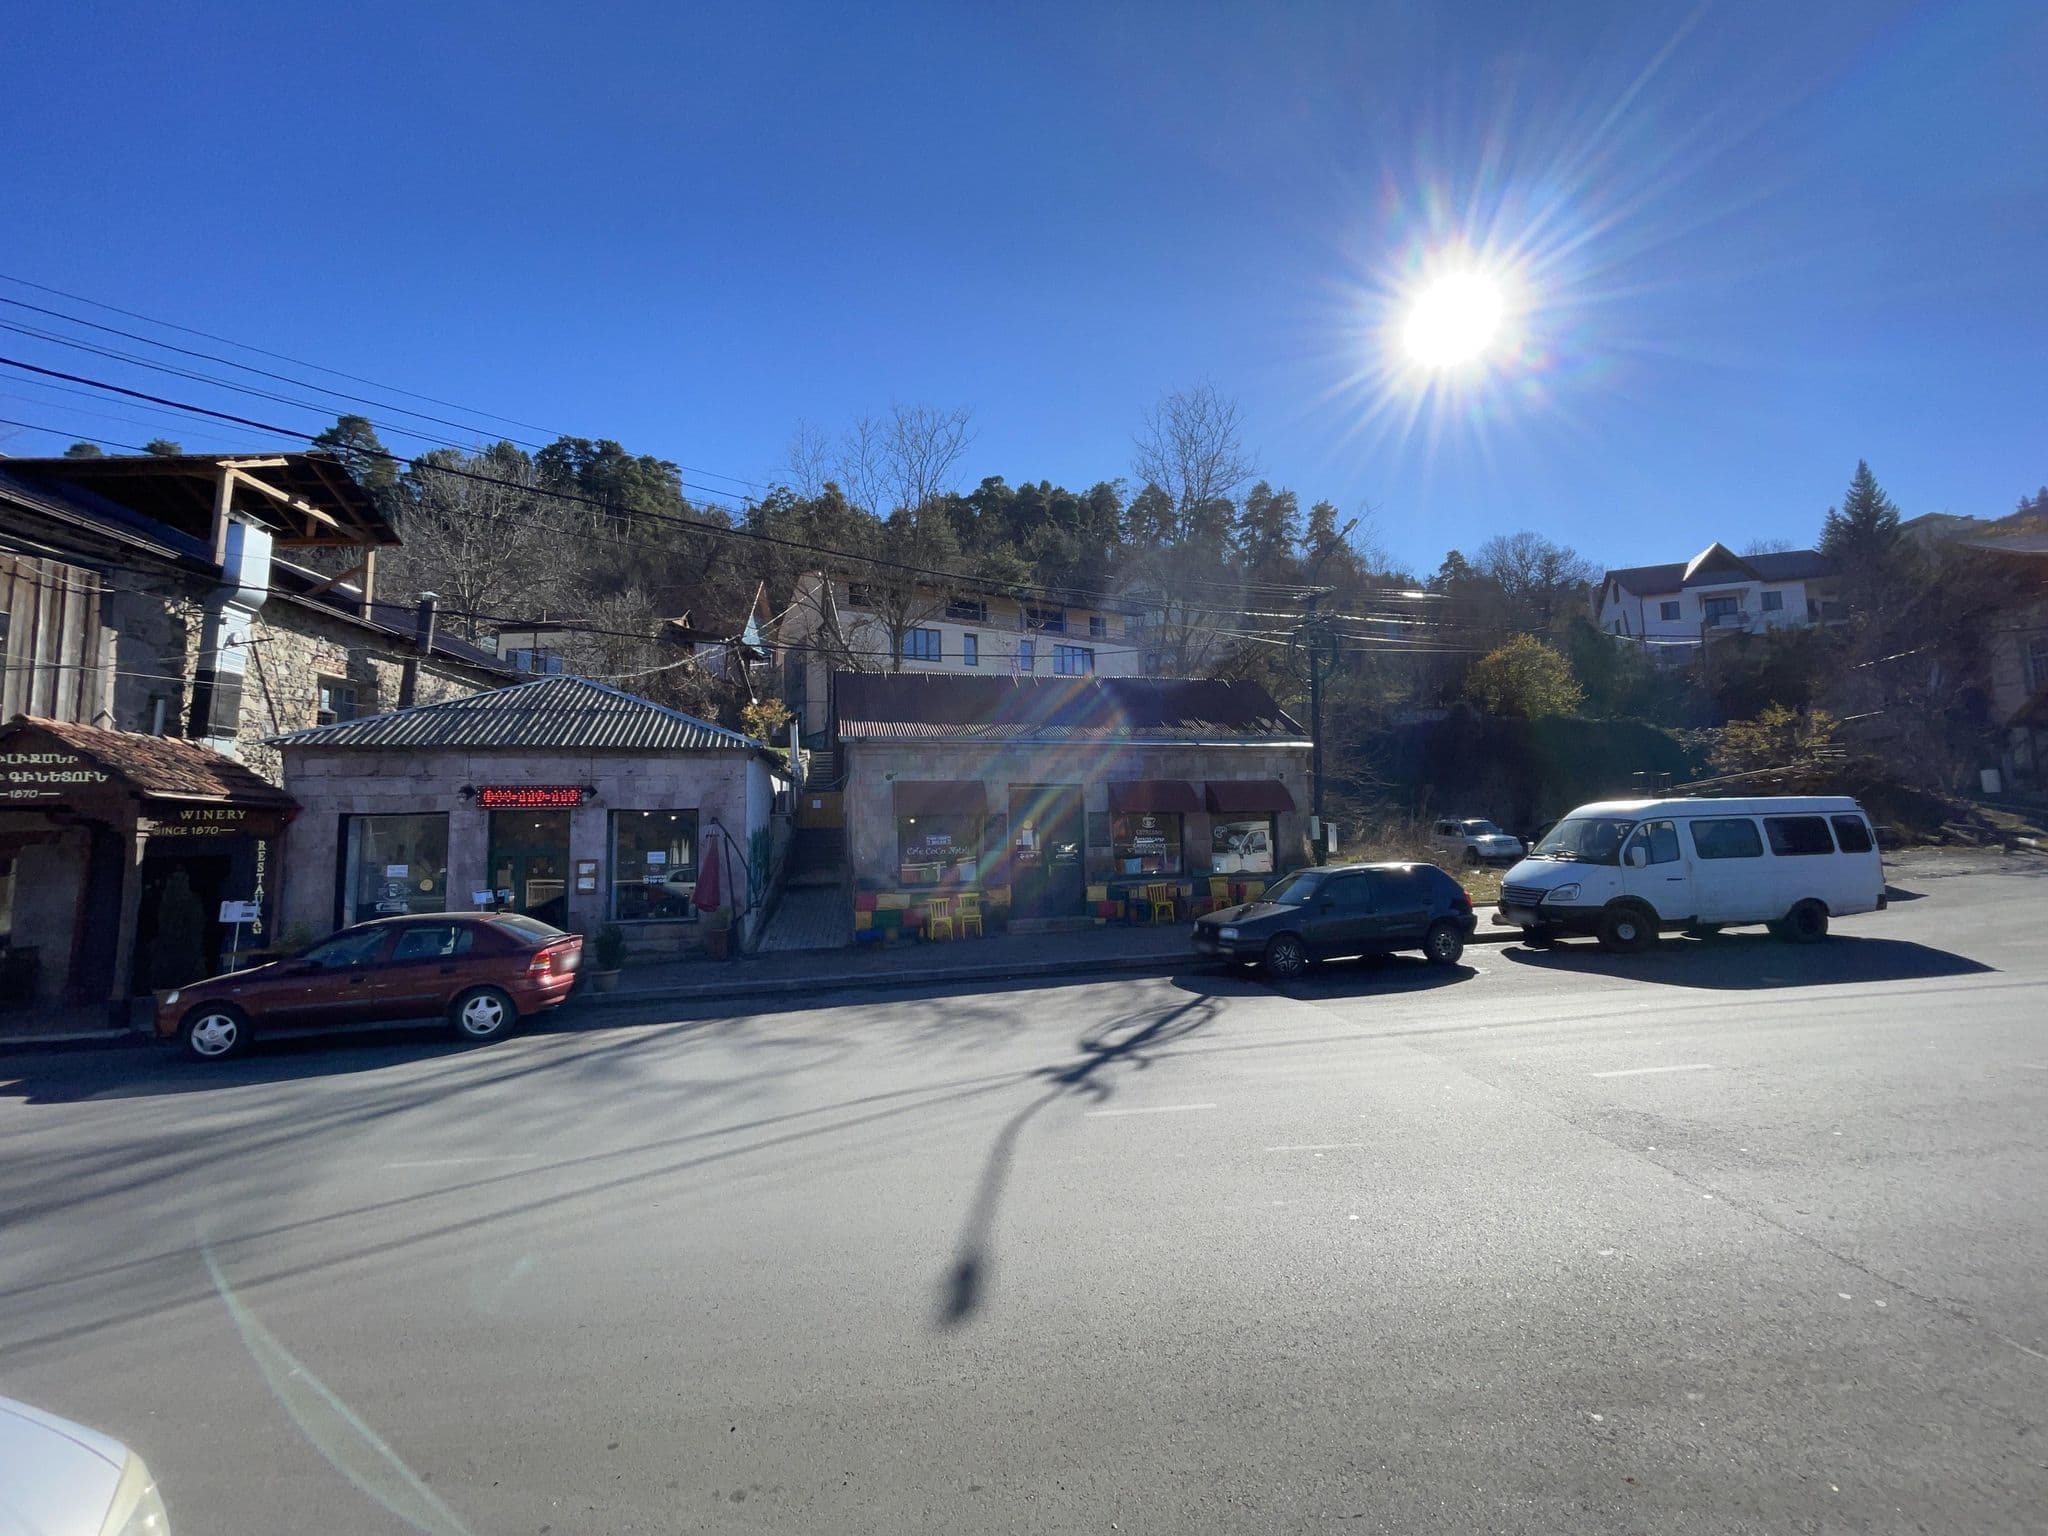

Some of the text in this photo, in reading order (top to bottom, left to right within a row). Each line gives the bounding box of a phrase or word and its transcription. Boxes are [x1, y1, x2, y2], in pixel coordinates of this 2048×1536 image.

[9, 789, 38, 799] 1870
[180, 809, 247, 820] WINERY
[153, 826, 219, 835] SINCE 1870
